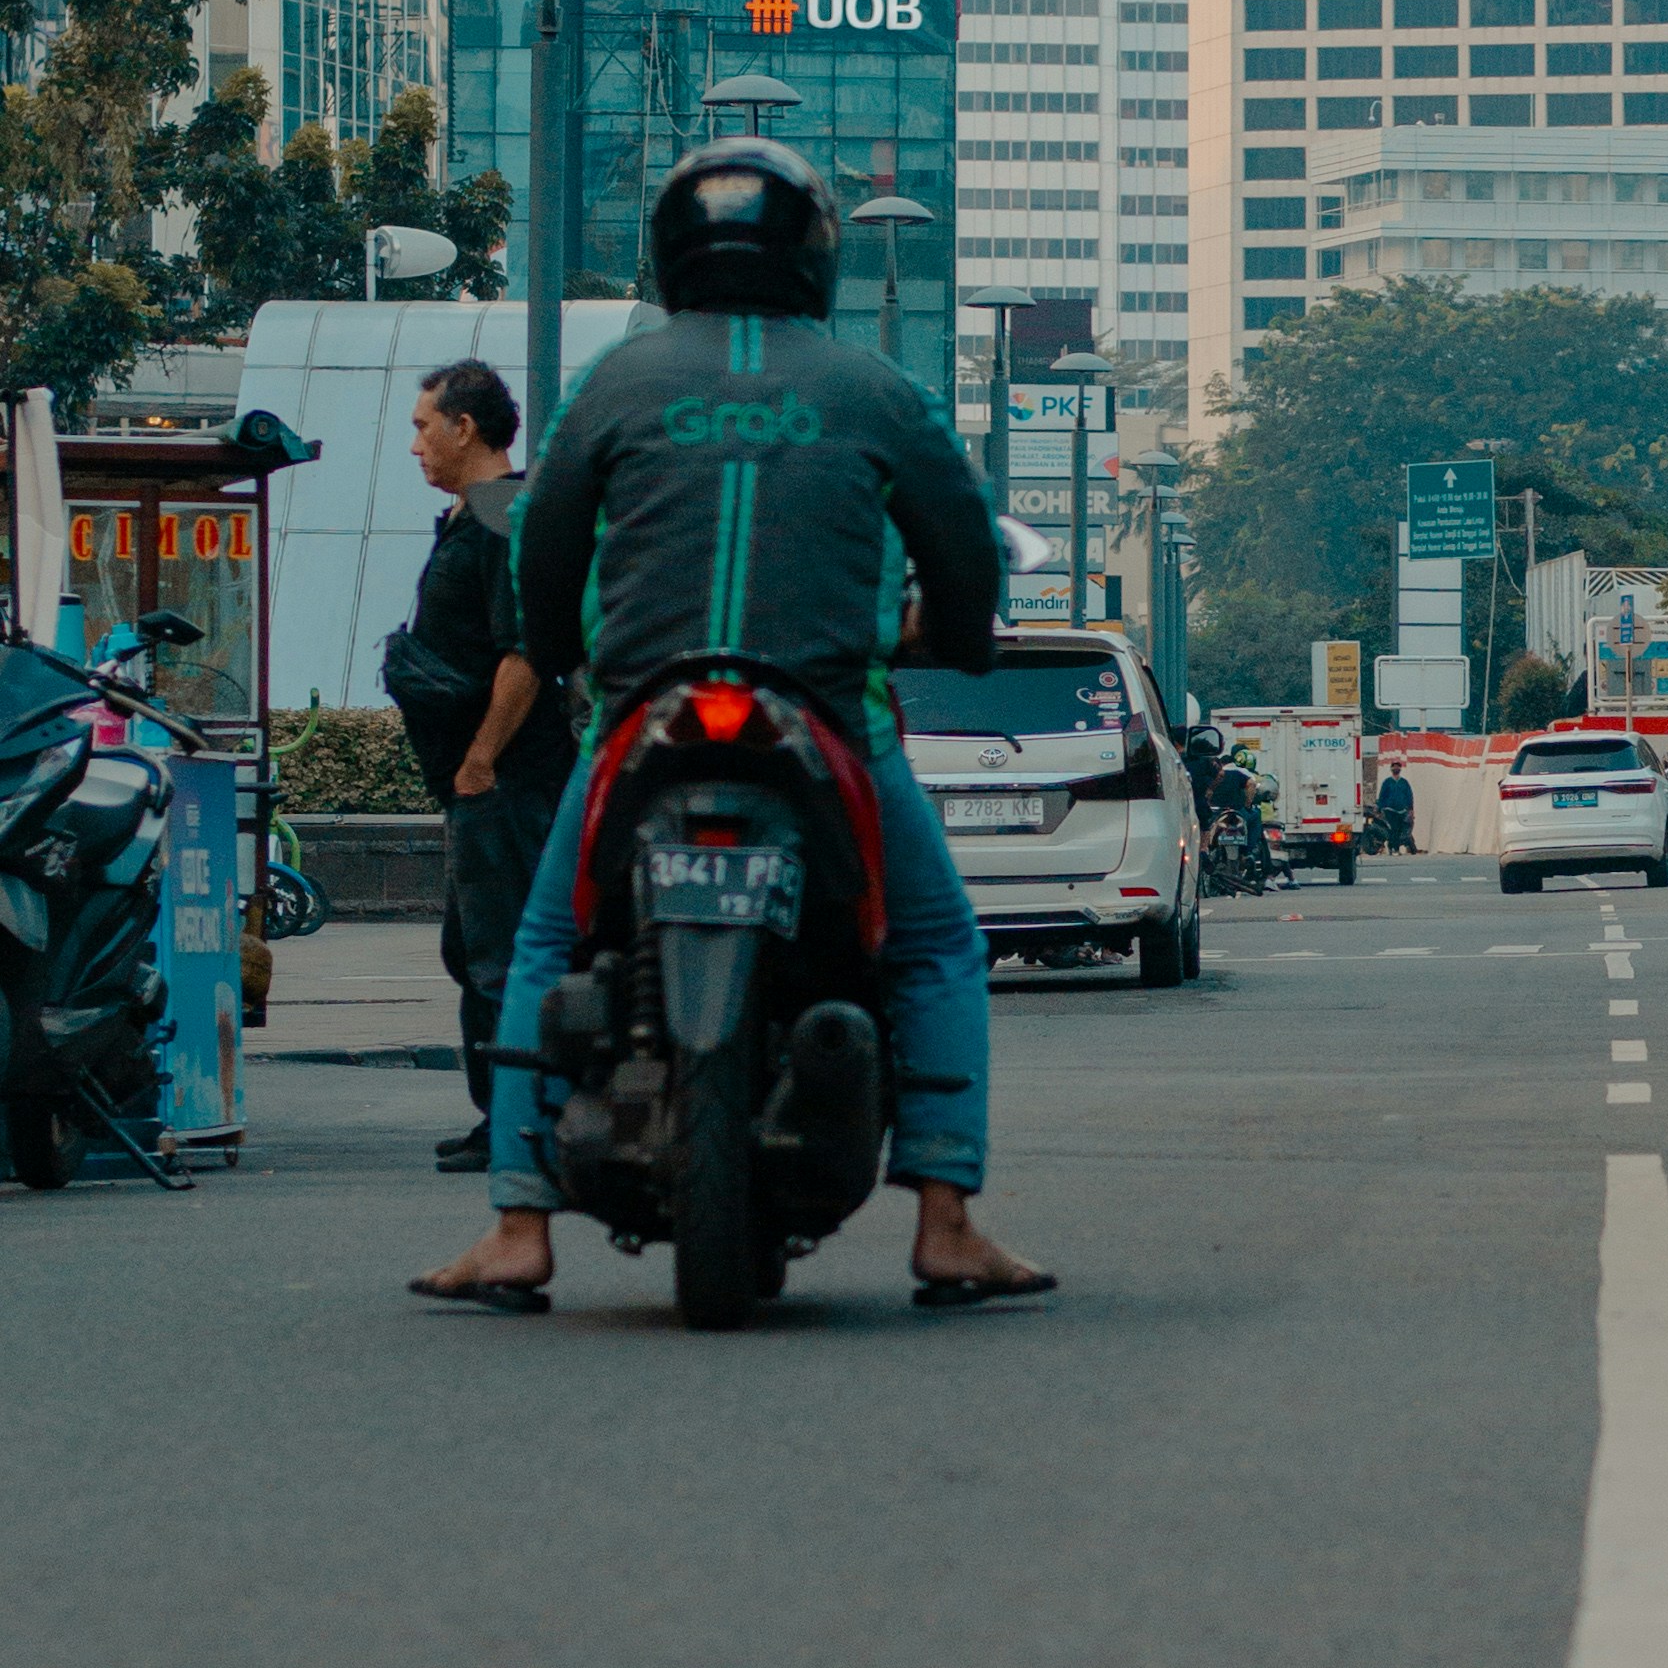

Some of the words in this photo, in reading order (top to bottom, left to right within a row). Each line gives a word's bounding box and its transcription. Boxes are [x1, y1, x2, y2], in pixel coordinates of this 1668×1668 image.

[662, 389, 823, 446] Grab
[1009, 596, 1069, 609] mandiri
[947, 801, 956, 816] B
[965, 800, 1003, 816] 2782
[1013, 799, 1041, 816] KKE
